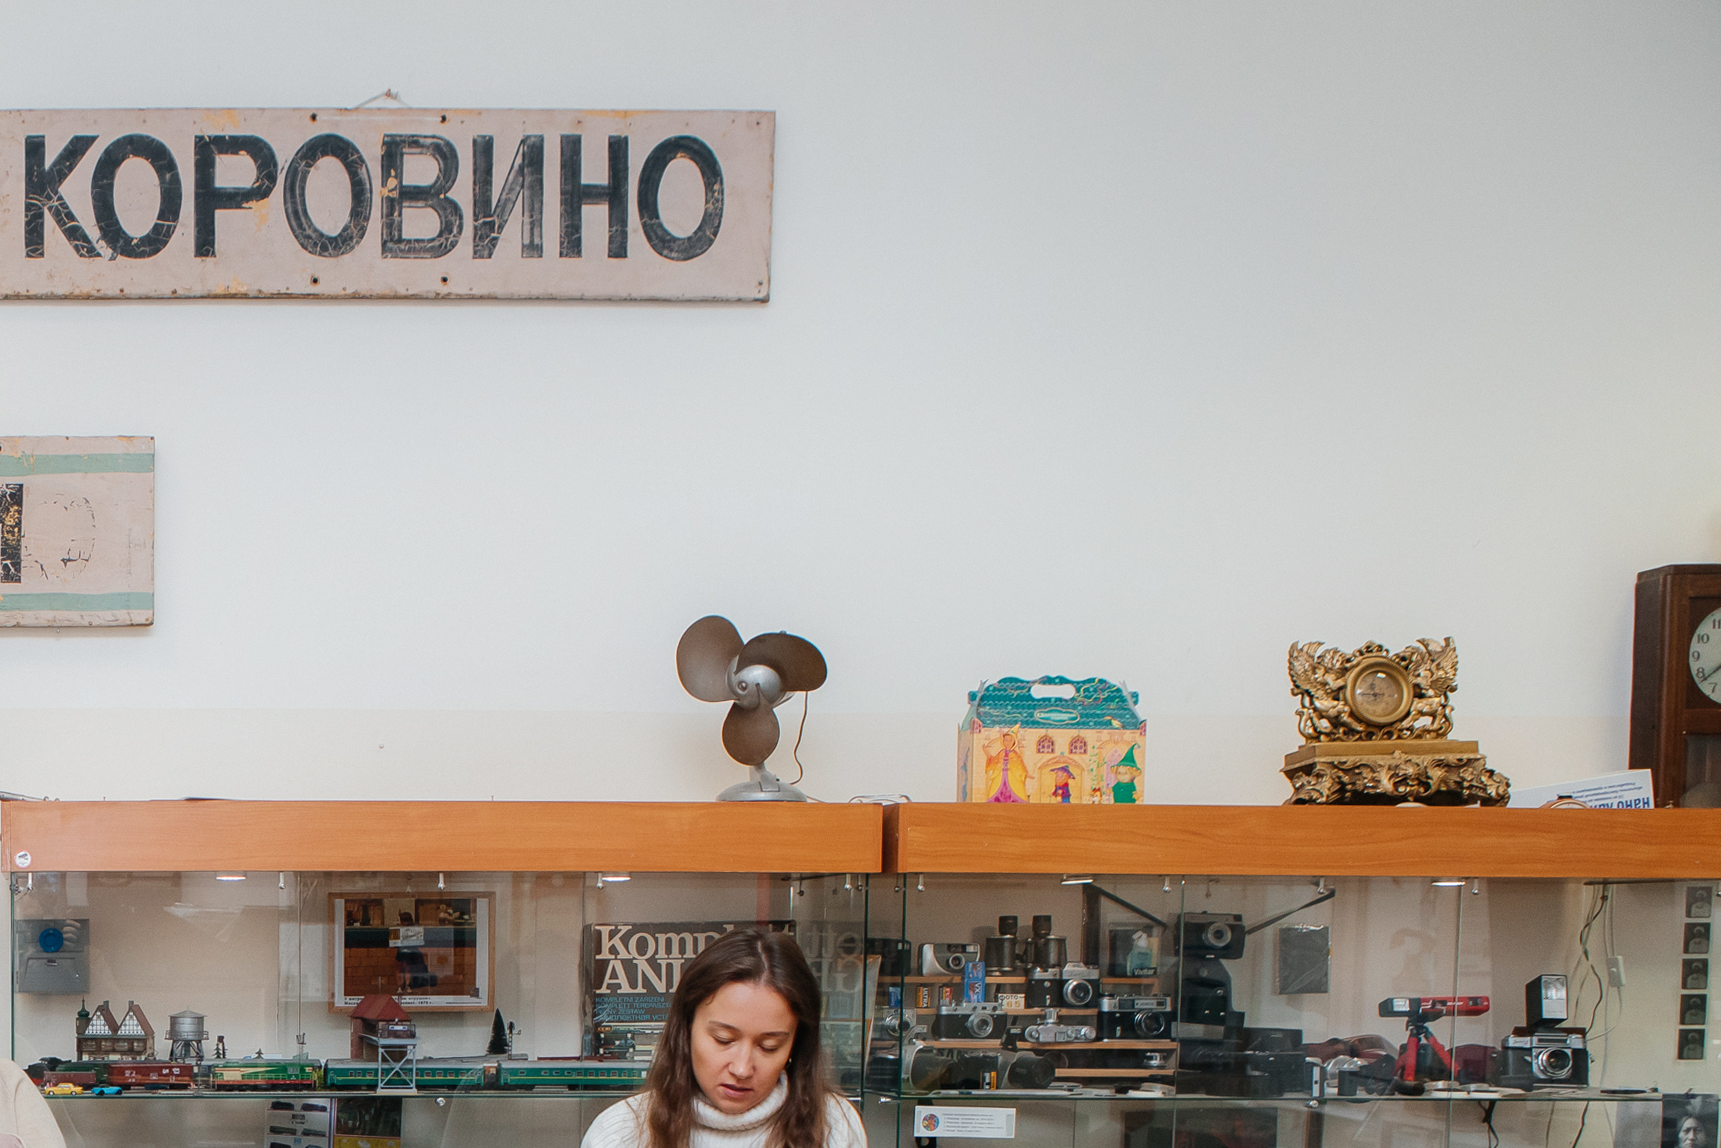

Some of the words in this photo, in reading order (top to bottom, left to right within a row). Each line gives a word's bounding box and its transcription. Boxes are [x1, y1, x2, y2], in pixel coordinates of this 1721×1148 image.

[23, 133, 724, 262] КОРОВИНО
[1696, 633, 1709, 644] 10
[1691, 650, 1701, 662] 9
[1695, 666, 1705, 679] 8
[1708, 682, 1718, 694] 7
[594, 924, 735, 960] Komp
[595, 959, 685, 993] ANL
[1133, 967, 1156, 976] Vivitar
